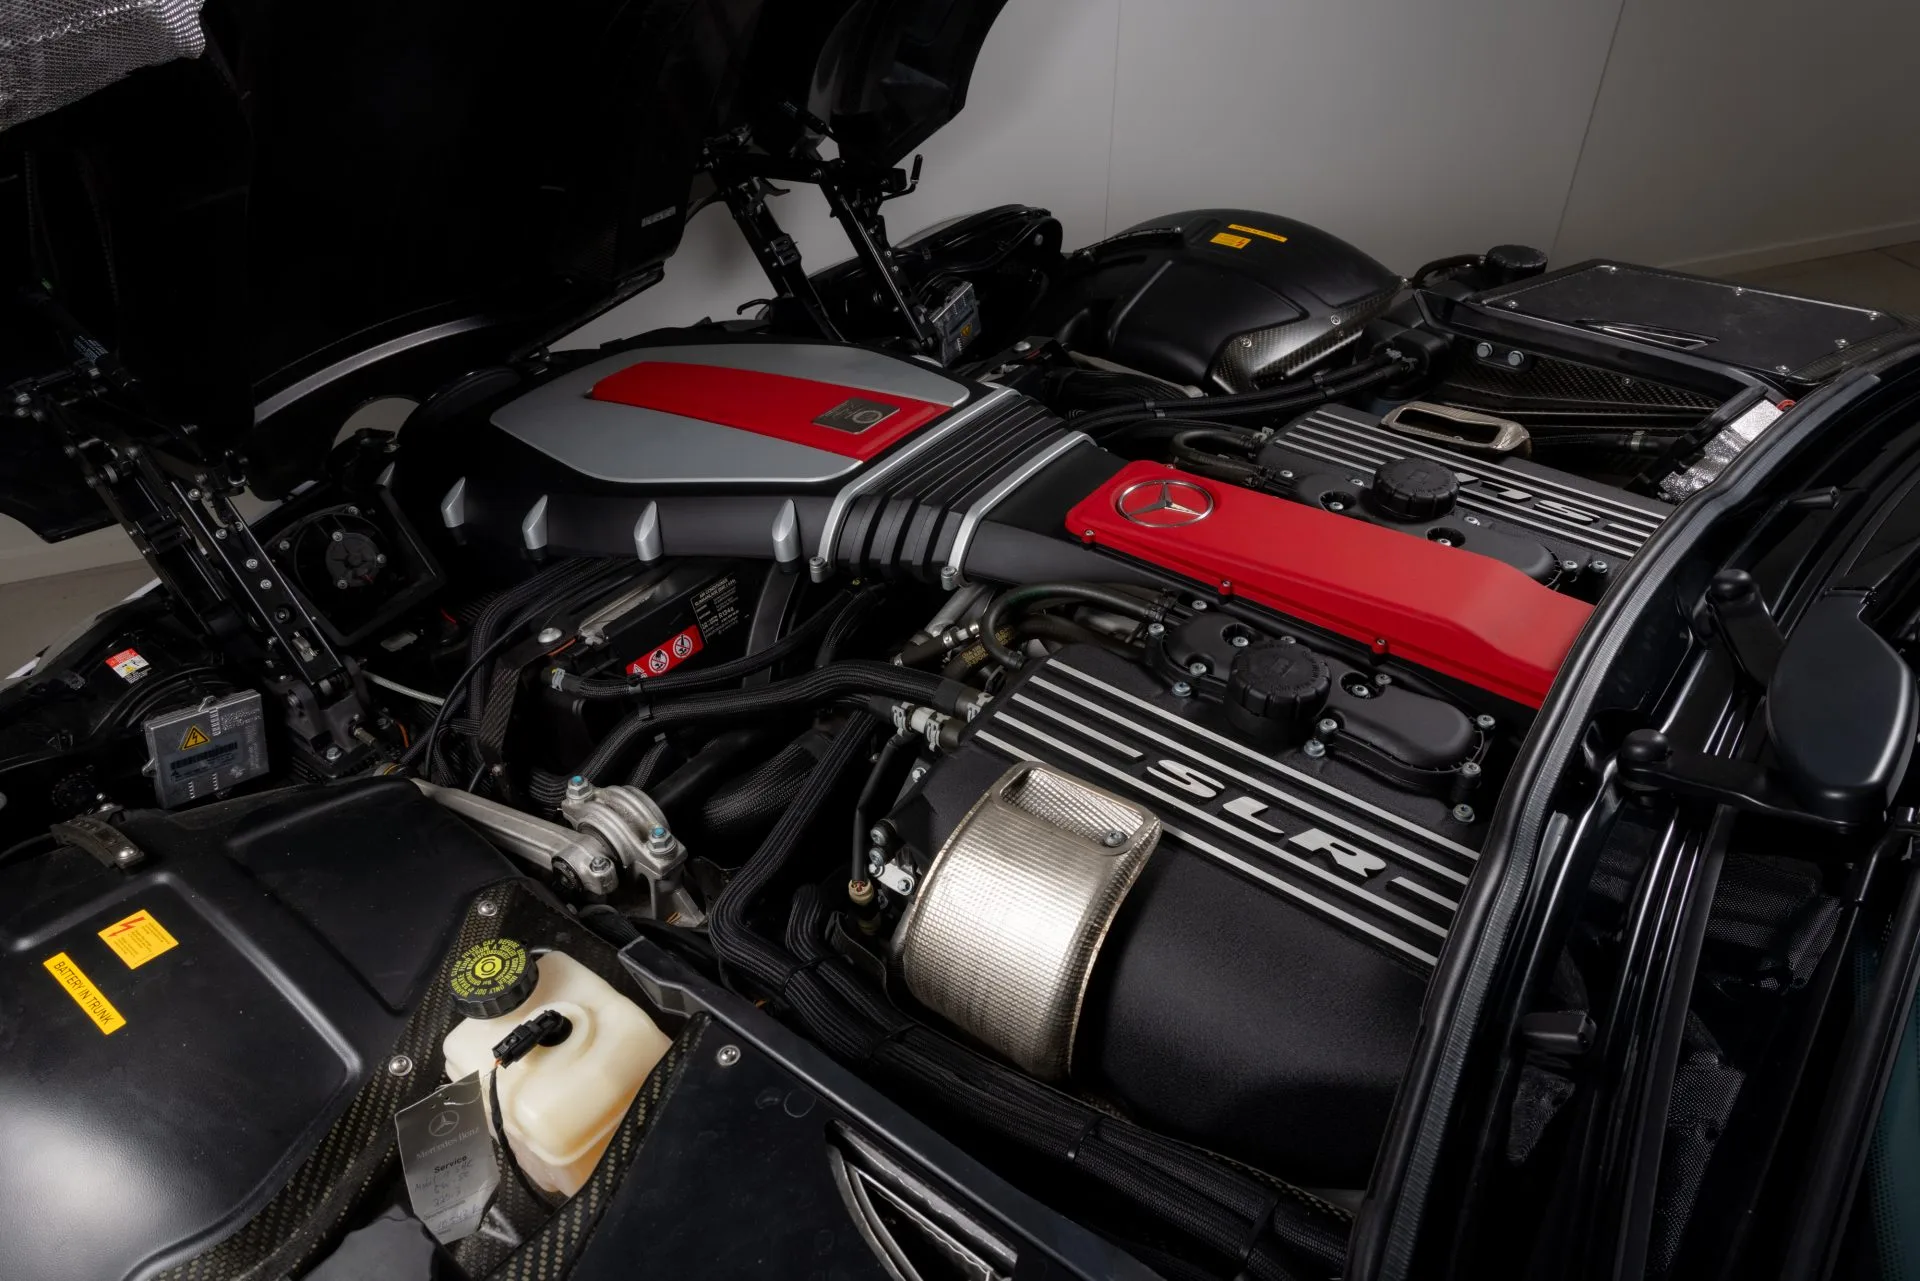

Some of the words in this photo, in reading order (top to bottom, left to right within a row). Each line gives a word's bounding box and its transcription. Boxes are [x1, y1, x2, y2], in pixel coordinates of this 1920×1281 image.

[1146, 758, 1388, 879] SLR
[53, 961, 85, 991] BATTERY
[78, 986, 91, 1000] IN
[86, 996, 116, 1026] TRUNK
[434, 1155, 468, 1174] Service
